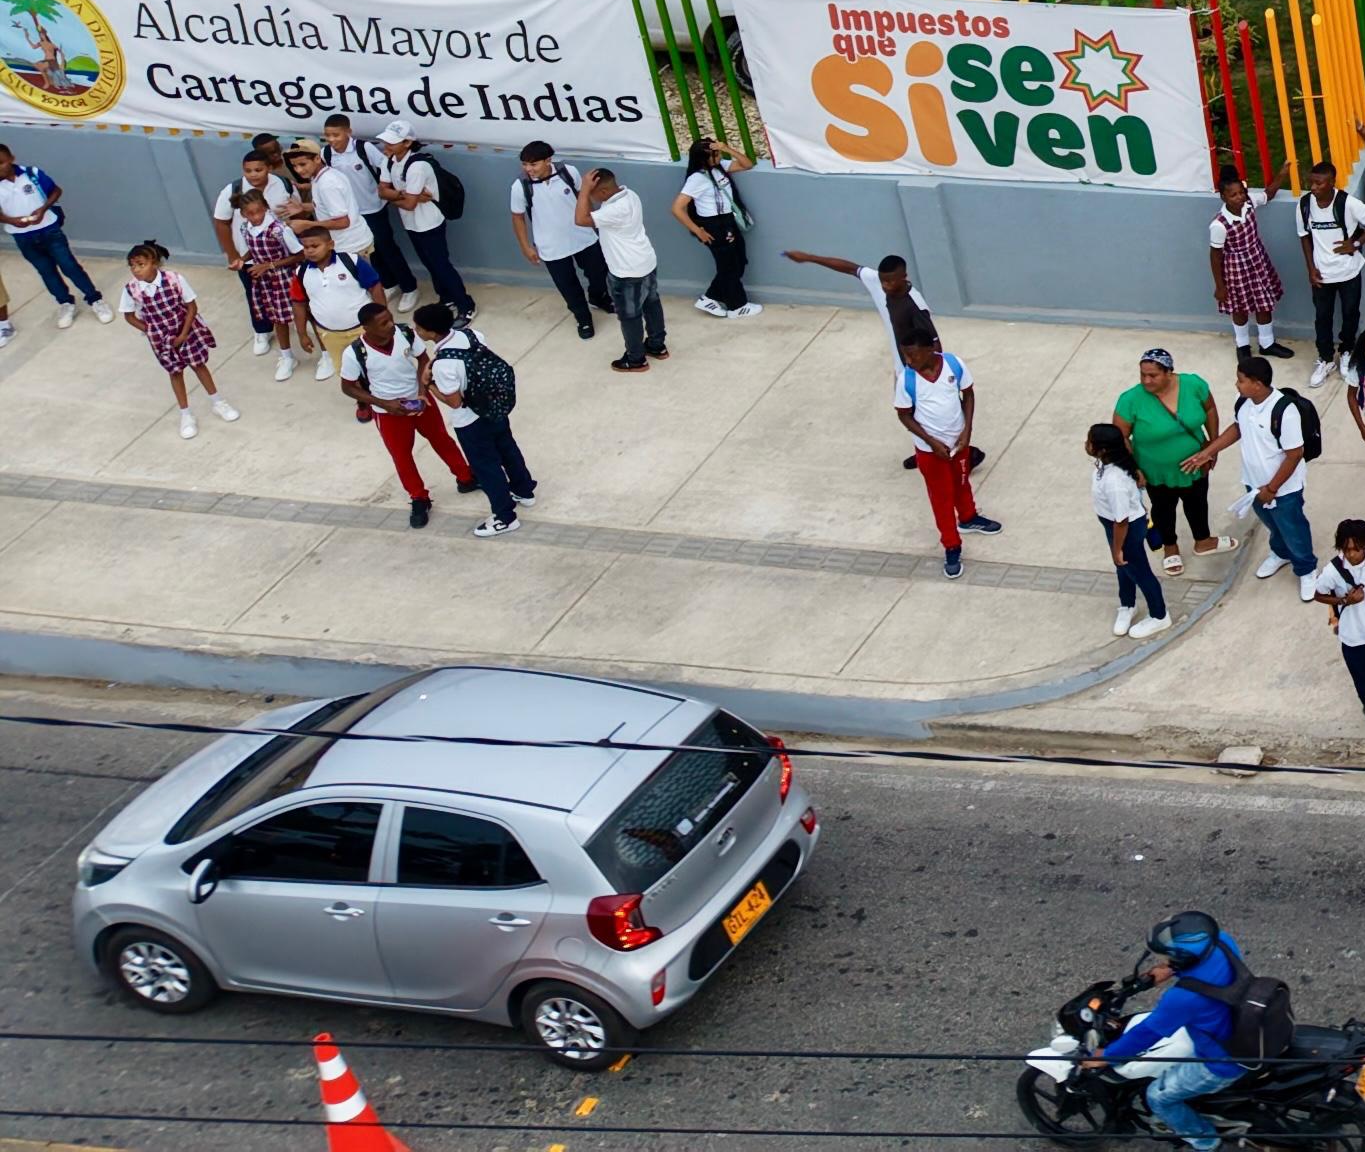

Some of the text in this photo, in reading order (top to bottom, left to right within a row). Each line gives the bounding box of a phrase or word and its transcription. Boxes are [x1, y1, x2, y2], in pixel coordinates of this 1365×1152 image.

[134, 0, 562, 66] Alcaldía Mayor de
[828, 3, 1010, 47] Impuestos
[833, 31, 896, 63] que
[146, 62, 643, 123] Cartagena de Indias
[946, 43, 1055, 106] se
[956, 110, 1157, 175] ven
